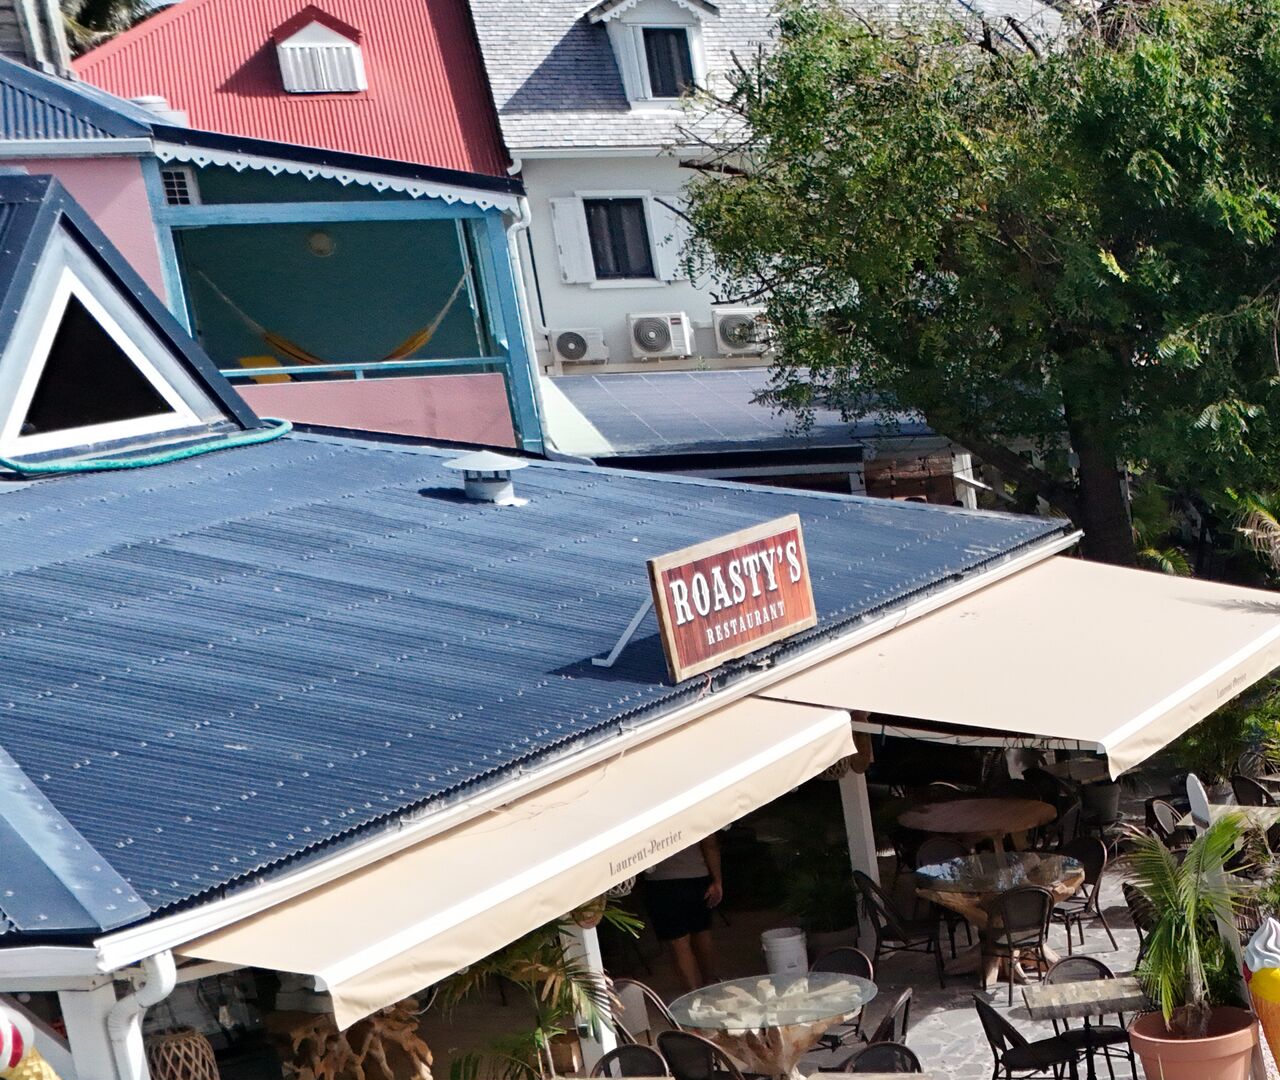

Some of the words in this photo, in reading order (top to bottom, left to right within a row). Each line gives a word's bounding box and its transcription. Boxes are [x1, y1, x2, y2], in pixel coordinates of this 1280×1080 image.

[669, 539, 802, 626] ROASTY'S
[706, 600, 787, 646] RESTAURANT
[608, 829, 684, 877] Laurent-Perrier
